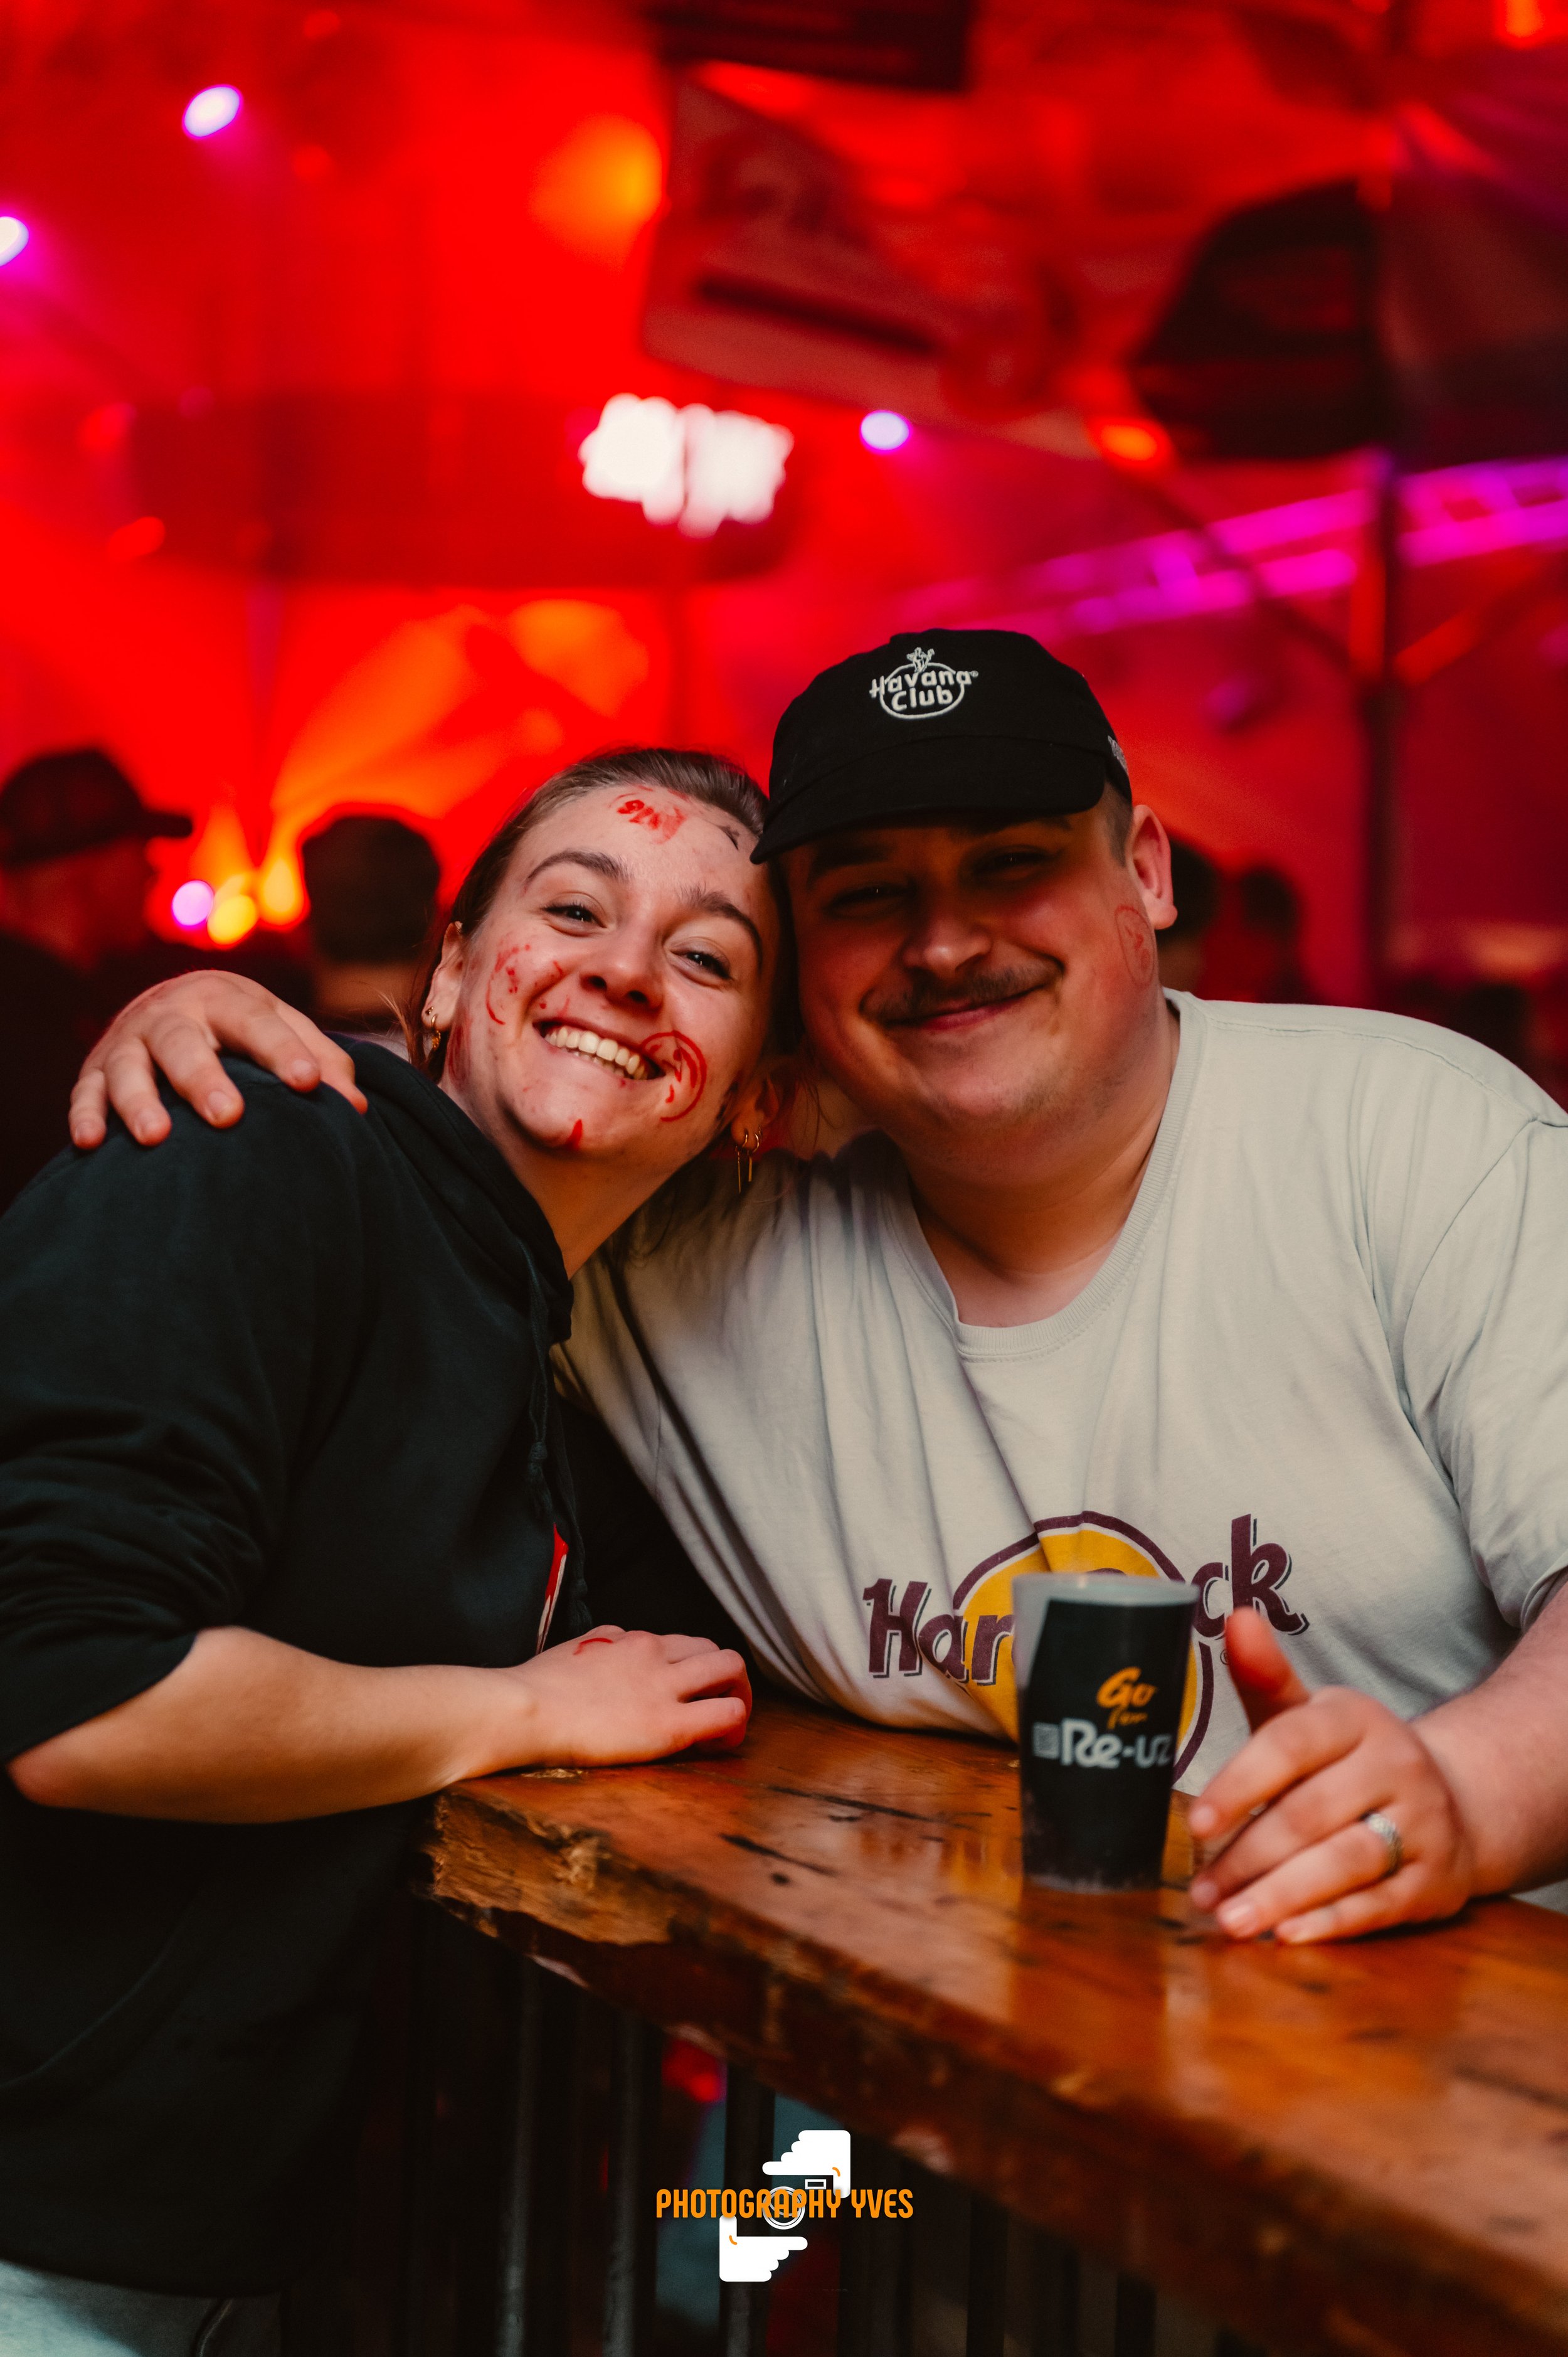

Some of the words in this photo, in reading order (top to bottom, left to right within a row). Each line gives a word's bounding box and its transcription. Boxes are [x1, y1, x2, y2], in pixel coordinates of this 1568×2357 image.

[869, 669, 973, 698] Havana
[891, 685, 953, 712] Club
[862, 1578, 1014, 1686] Har
[1096, 1666, 1157, 1709] Go
